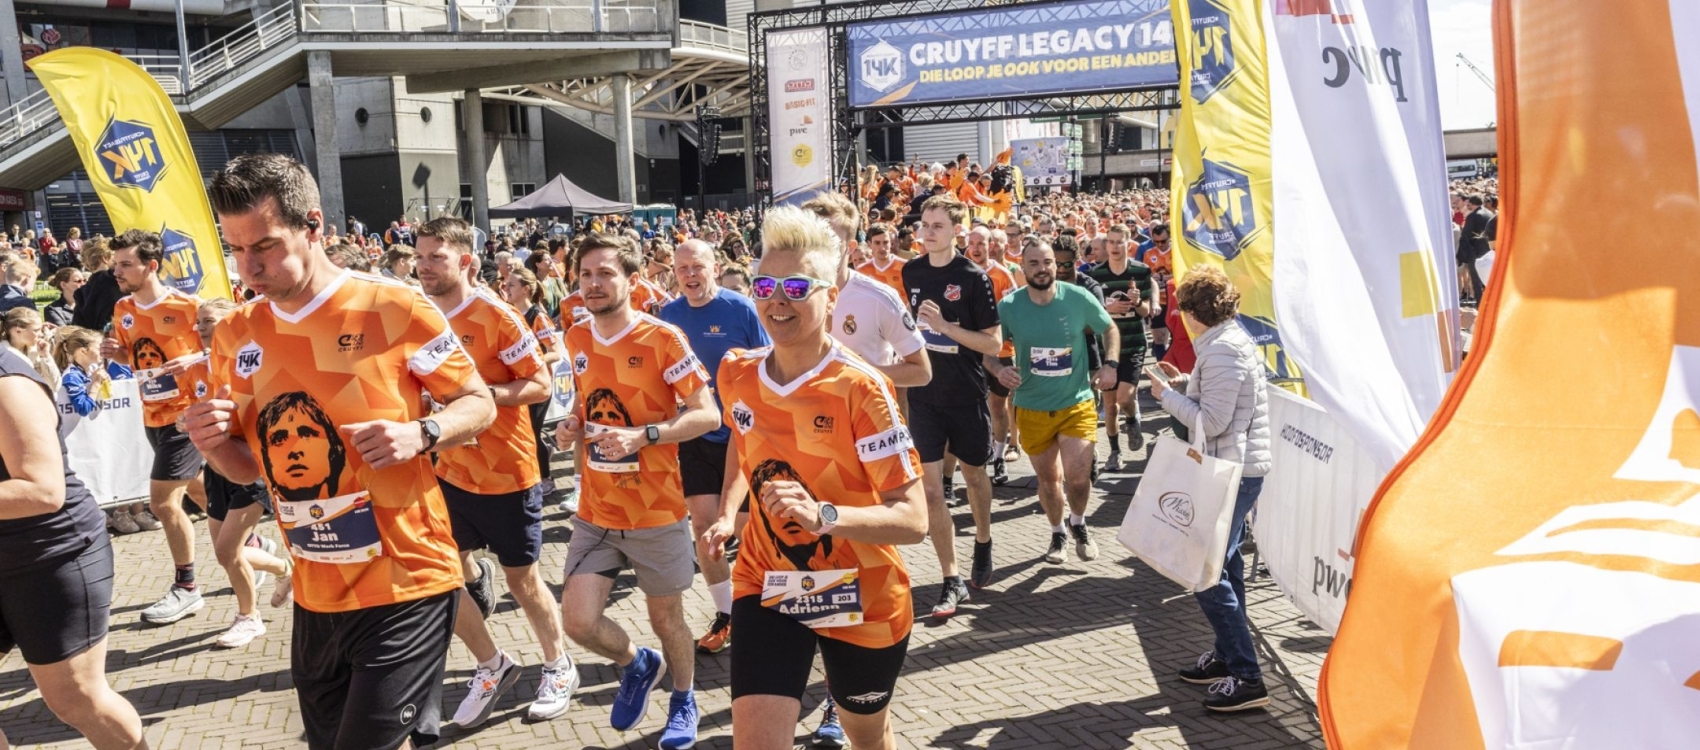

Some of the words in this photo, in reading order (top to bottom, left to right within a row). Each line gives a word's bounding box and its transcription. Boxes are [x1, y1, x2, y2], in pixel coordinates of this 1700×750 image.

[909, 37, 1014, 66] CRUYFF
[1018, 22, 1136, 58] LEGACY
[863, 57, 898, 77] 14K
[919, 69, 942, 83] DIE
[944, 66, 984, 81] LOOP
[986, 65, 1003, 79] JE
[1003, 60, 1039, 77] OOK
[1040, 56, 1089, 74] VOOR
[1091, 54, 1122, 69] EEN
[787, 81, 811, 89] OTTO
[790, 127, 808, 136] pwc
[911, 294, 917, 306] 6
[238, 352, 261, 368] 14K
[733, 411, 751, 427] 14K
[1280, 423, 1334, 465] HOOFDSPONSOR
[311, 522, 331, 531] 451
[312, 531, 339, 542] Jan
[796, 595, 823, 603] 2315
